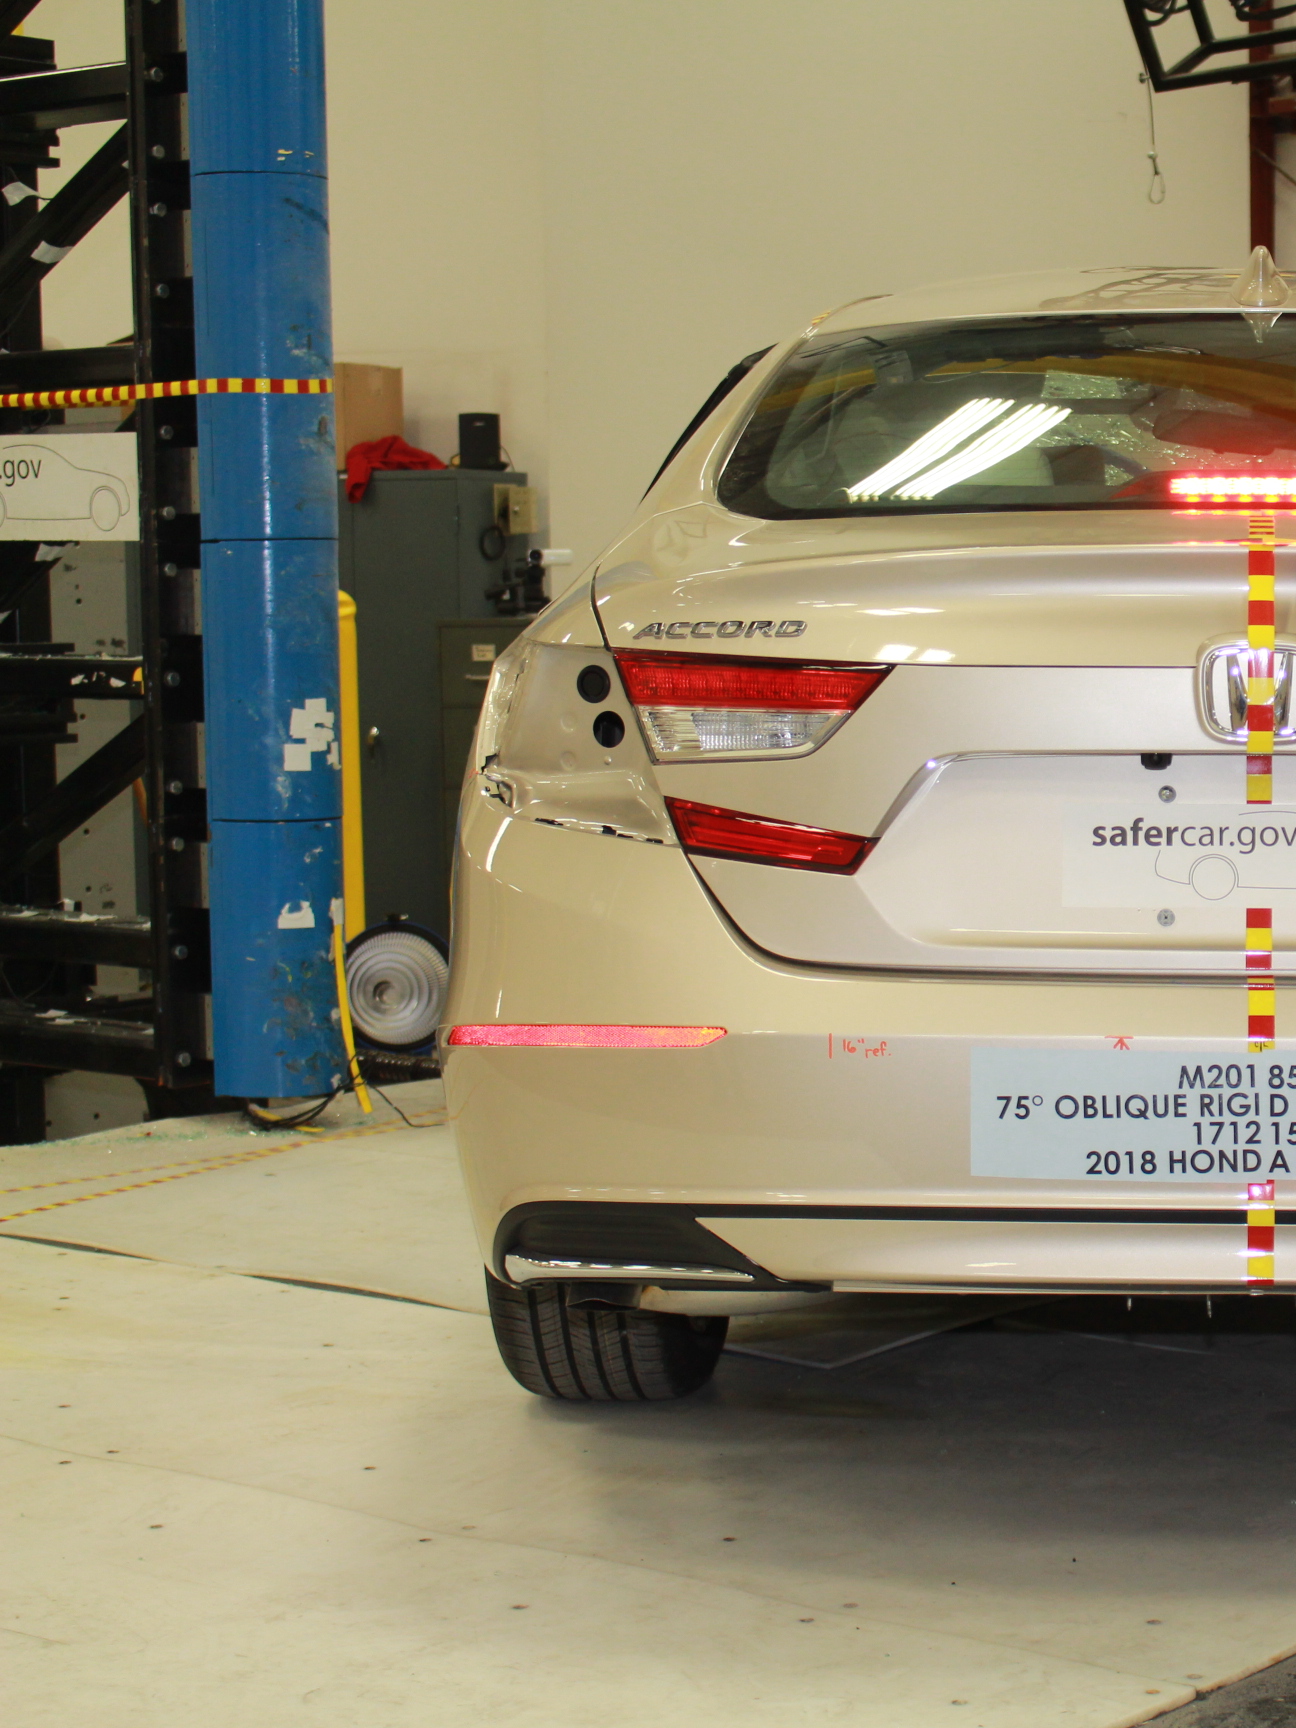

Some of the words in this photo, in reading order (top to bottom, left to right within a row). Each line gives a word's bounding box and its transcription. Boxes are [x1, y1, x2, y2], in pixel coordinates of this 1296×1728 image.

[633, 620, 808, 640] ACCORD
[1054, 1093, 1188, 1120] OBLIQUE
[1085, 1150, 1157, 1175] 2018
[1168, 1149, 1291, 1174] HONDA
